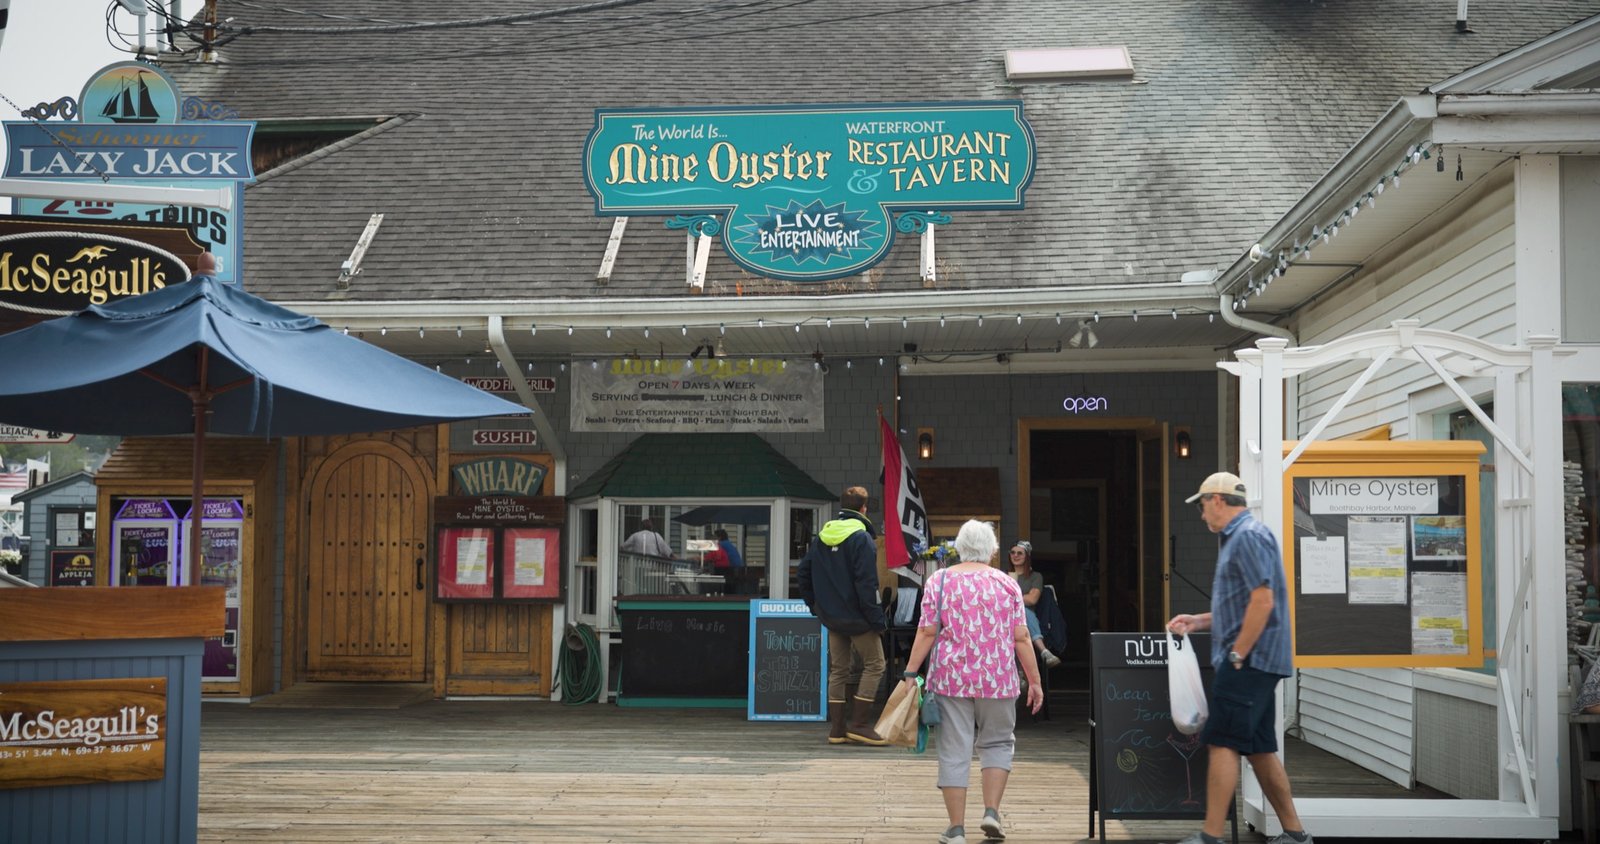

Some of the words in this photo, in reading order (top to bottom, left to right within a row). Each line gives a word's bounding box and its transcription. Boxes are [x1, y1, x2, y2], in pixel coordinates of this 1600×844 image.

[632, 124, 655, 141] The
[658, 123, 704, 140] World
[846, 120, 945, 135] WATERFRONT
[848, 131, 1011, 166] RESTAURANT
[20, 148, 124, 175] LAZY
[133, 148, 238, 175] JACK
[605, 143, 699, 185] Mine
[707, 141, 832, 188] Oyster
[847, 168, 883, 195] &
[889, 158, 1010, 192] TAVERN
[776, 212, 840, 228] LIVE
[760, 230, 860, 249] ENTERTAINMENT
[466, 379, 500, 391] WOOD
[672, 381, 679, 389] 7
[1063, 396, 1107, 414] open
[1, 427, 34, 436] LEJACK
[480, 431, 530, 443] SUSHI
[457, 461, 542, 496] WHARF
[1311, 479, 1361, 496] Mine
[1368, 479, 1436, 501] Oyster
[134, 502, 156, 510] TICKET
[137, 506, 162, 514] LOCKER
[203, 502, 225, 510] TICKET
[207, 506, 232, 514] LOCKER
[474, 505, 491, 513] MINE
[496, 505, 525, 513] OYSTER
[1329, 504, 1365, 512] Boothbay
[1366, 504, 1392, 512] Harbor,
[59, 571, 93, 579] APPLEJA
[762, 603, 784, 613] BUD
[785, 603, 811, 613] LIGH
[0, 705, 159, 745] McSeagull's
[142, 743, 152, 751] W
